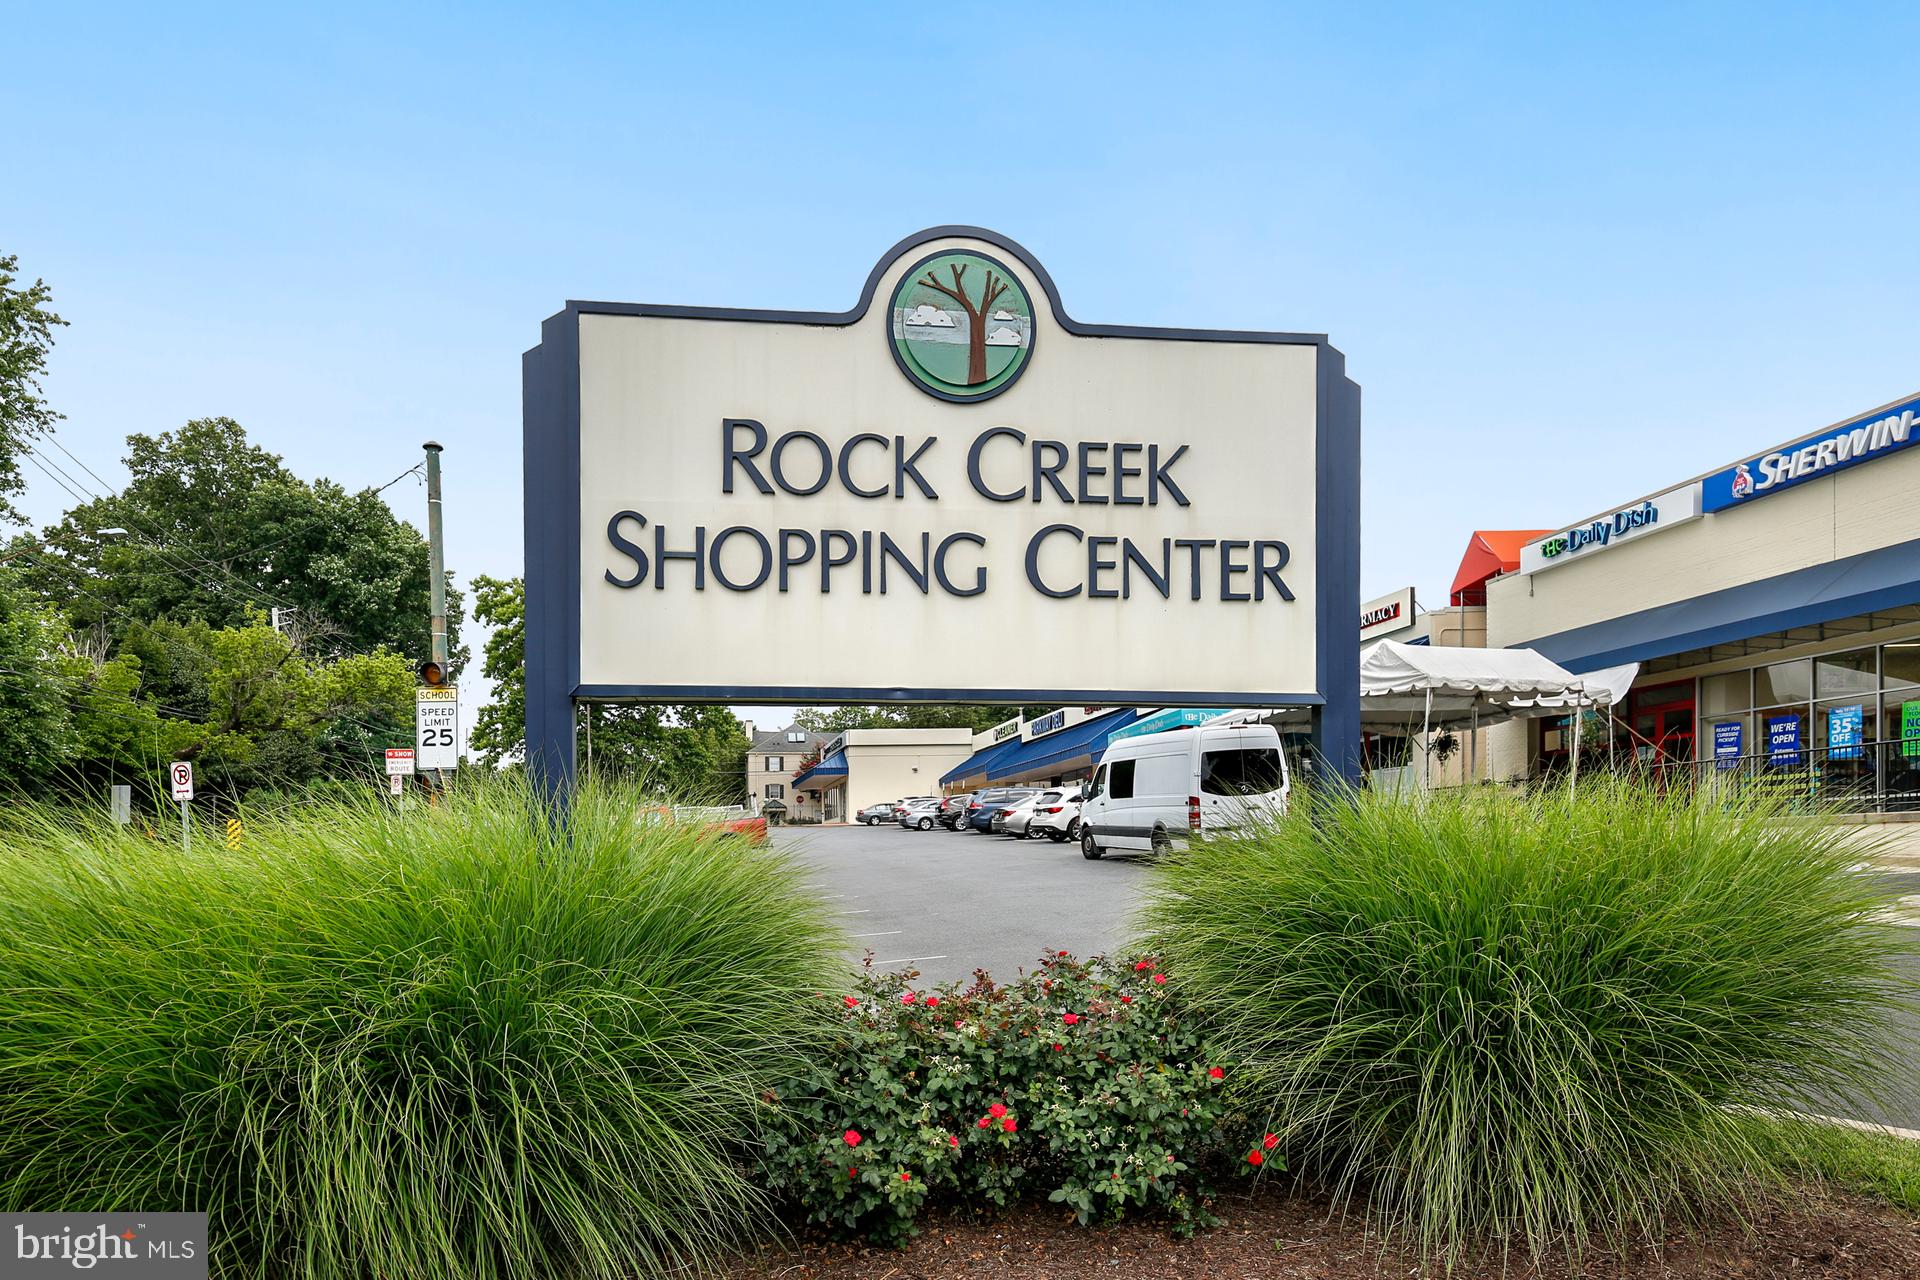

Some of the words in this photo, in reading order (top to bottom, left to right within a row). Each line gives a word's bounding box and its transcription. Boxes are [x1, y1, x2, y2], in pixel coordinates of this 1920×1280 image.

[721, 417, 939, 500] ROCK
[967, 425, 1192, 507] CREEK
[1566, 521, 1612, 553] Daily
[1611, 500, 1659, 537] Dish
[604, 509, 988, 597] SHOPPING
[1024, 523, 1297, 601] CENTER
[420, 691, 455, 699] SCHOOL
[421, 708, 455, 716] SPEED
[424, 719, 451, 727] LIMIT
[1770, 721, 1797, 733] WE'RE
[422, 729, 454, 747] 25
[1772, 733, 1796, 744] OPEN
[1831, 733, 1851, 743] OFF
